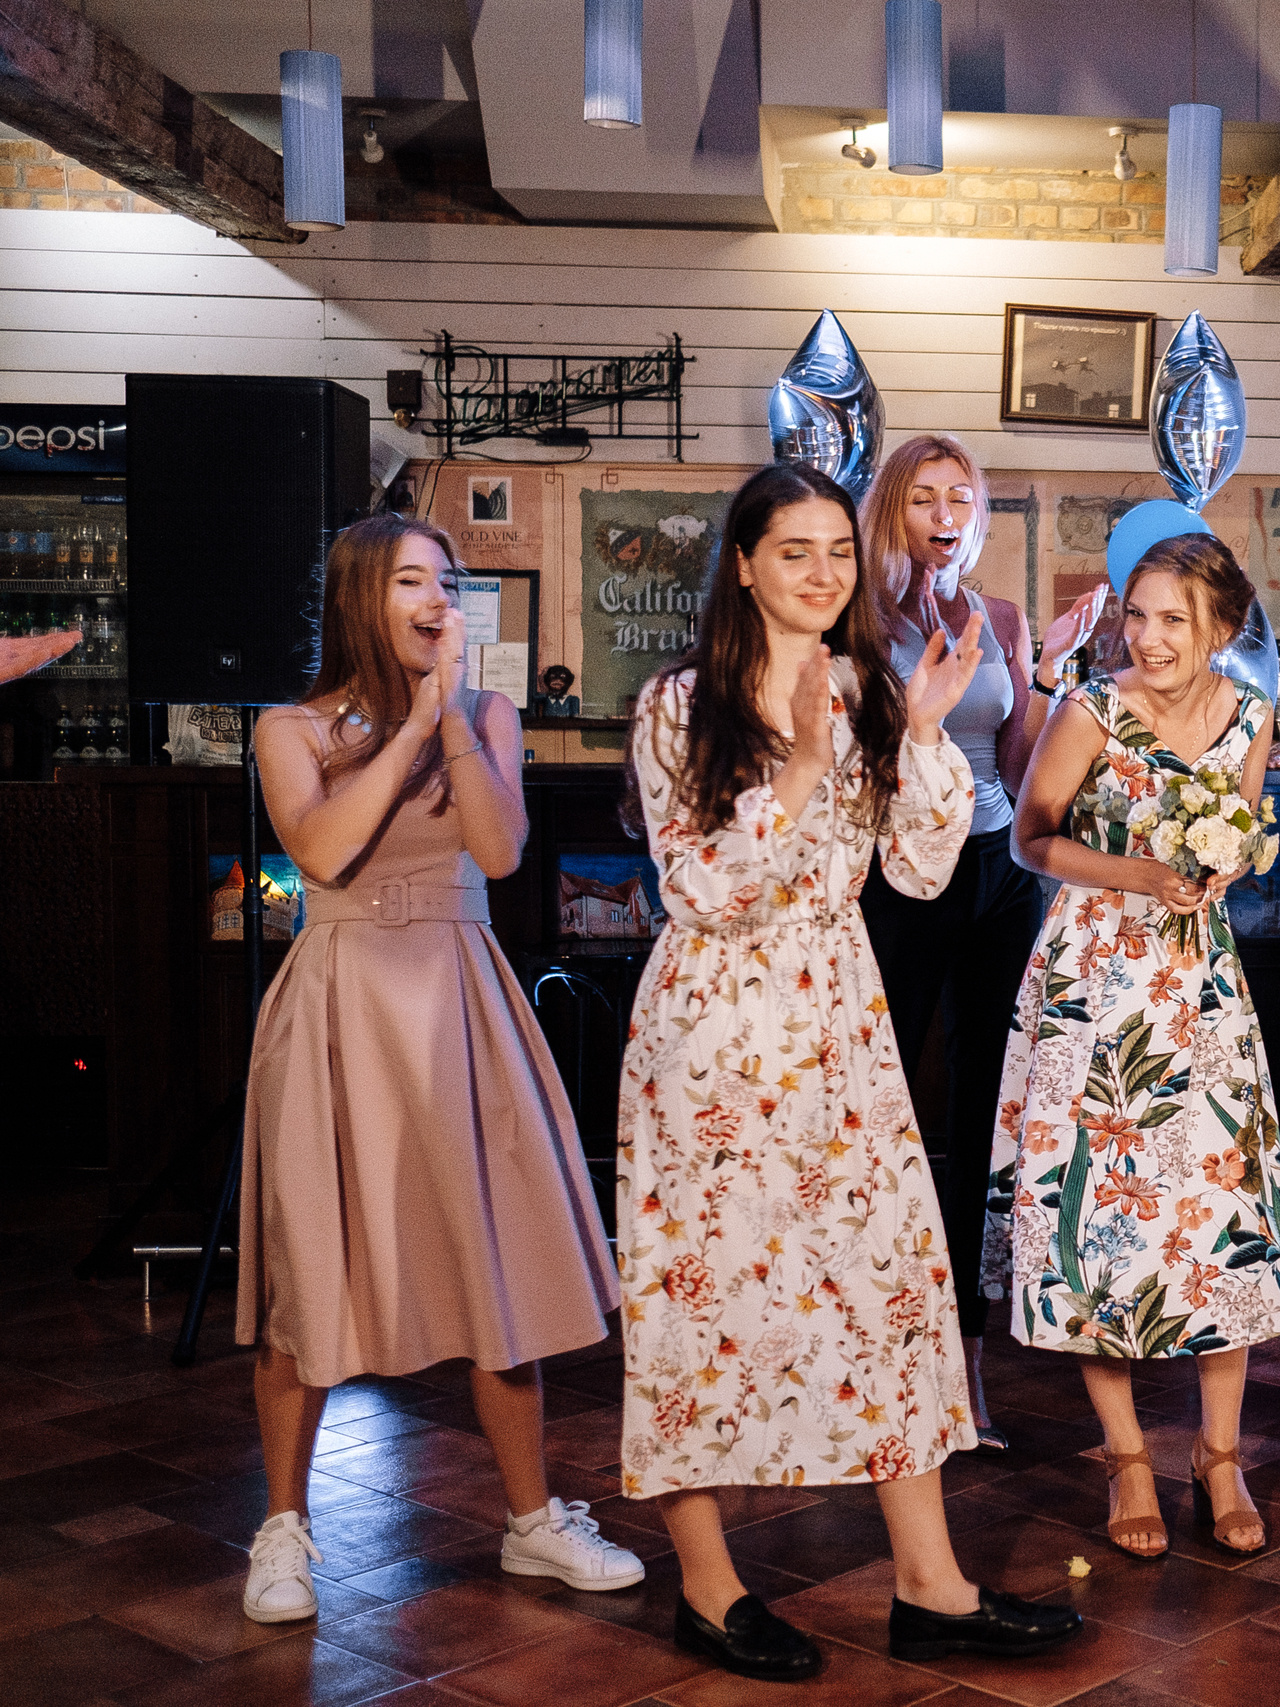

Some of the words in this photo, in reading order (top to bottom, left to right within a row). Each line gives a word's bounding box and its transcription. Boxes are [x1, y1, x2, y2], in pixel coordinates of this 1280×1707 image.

[461, 530, 489, 542] OLD
[493, 530, 522, 542] VINE
[599, 572, 710, 613] Califor
